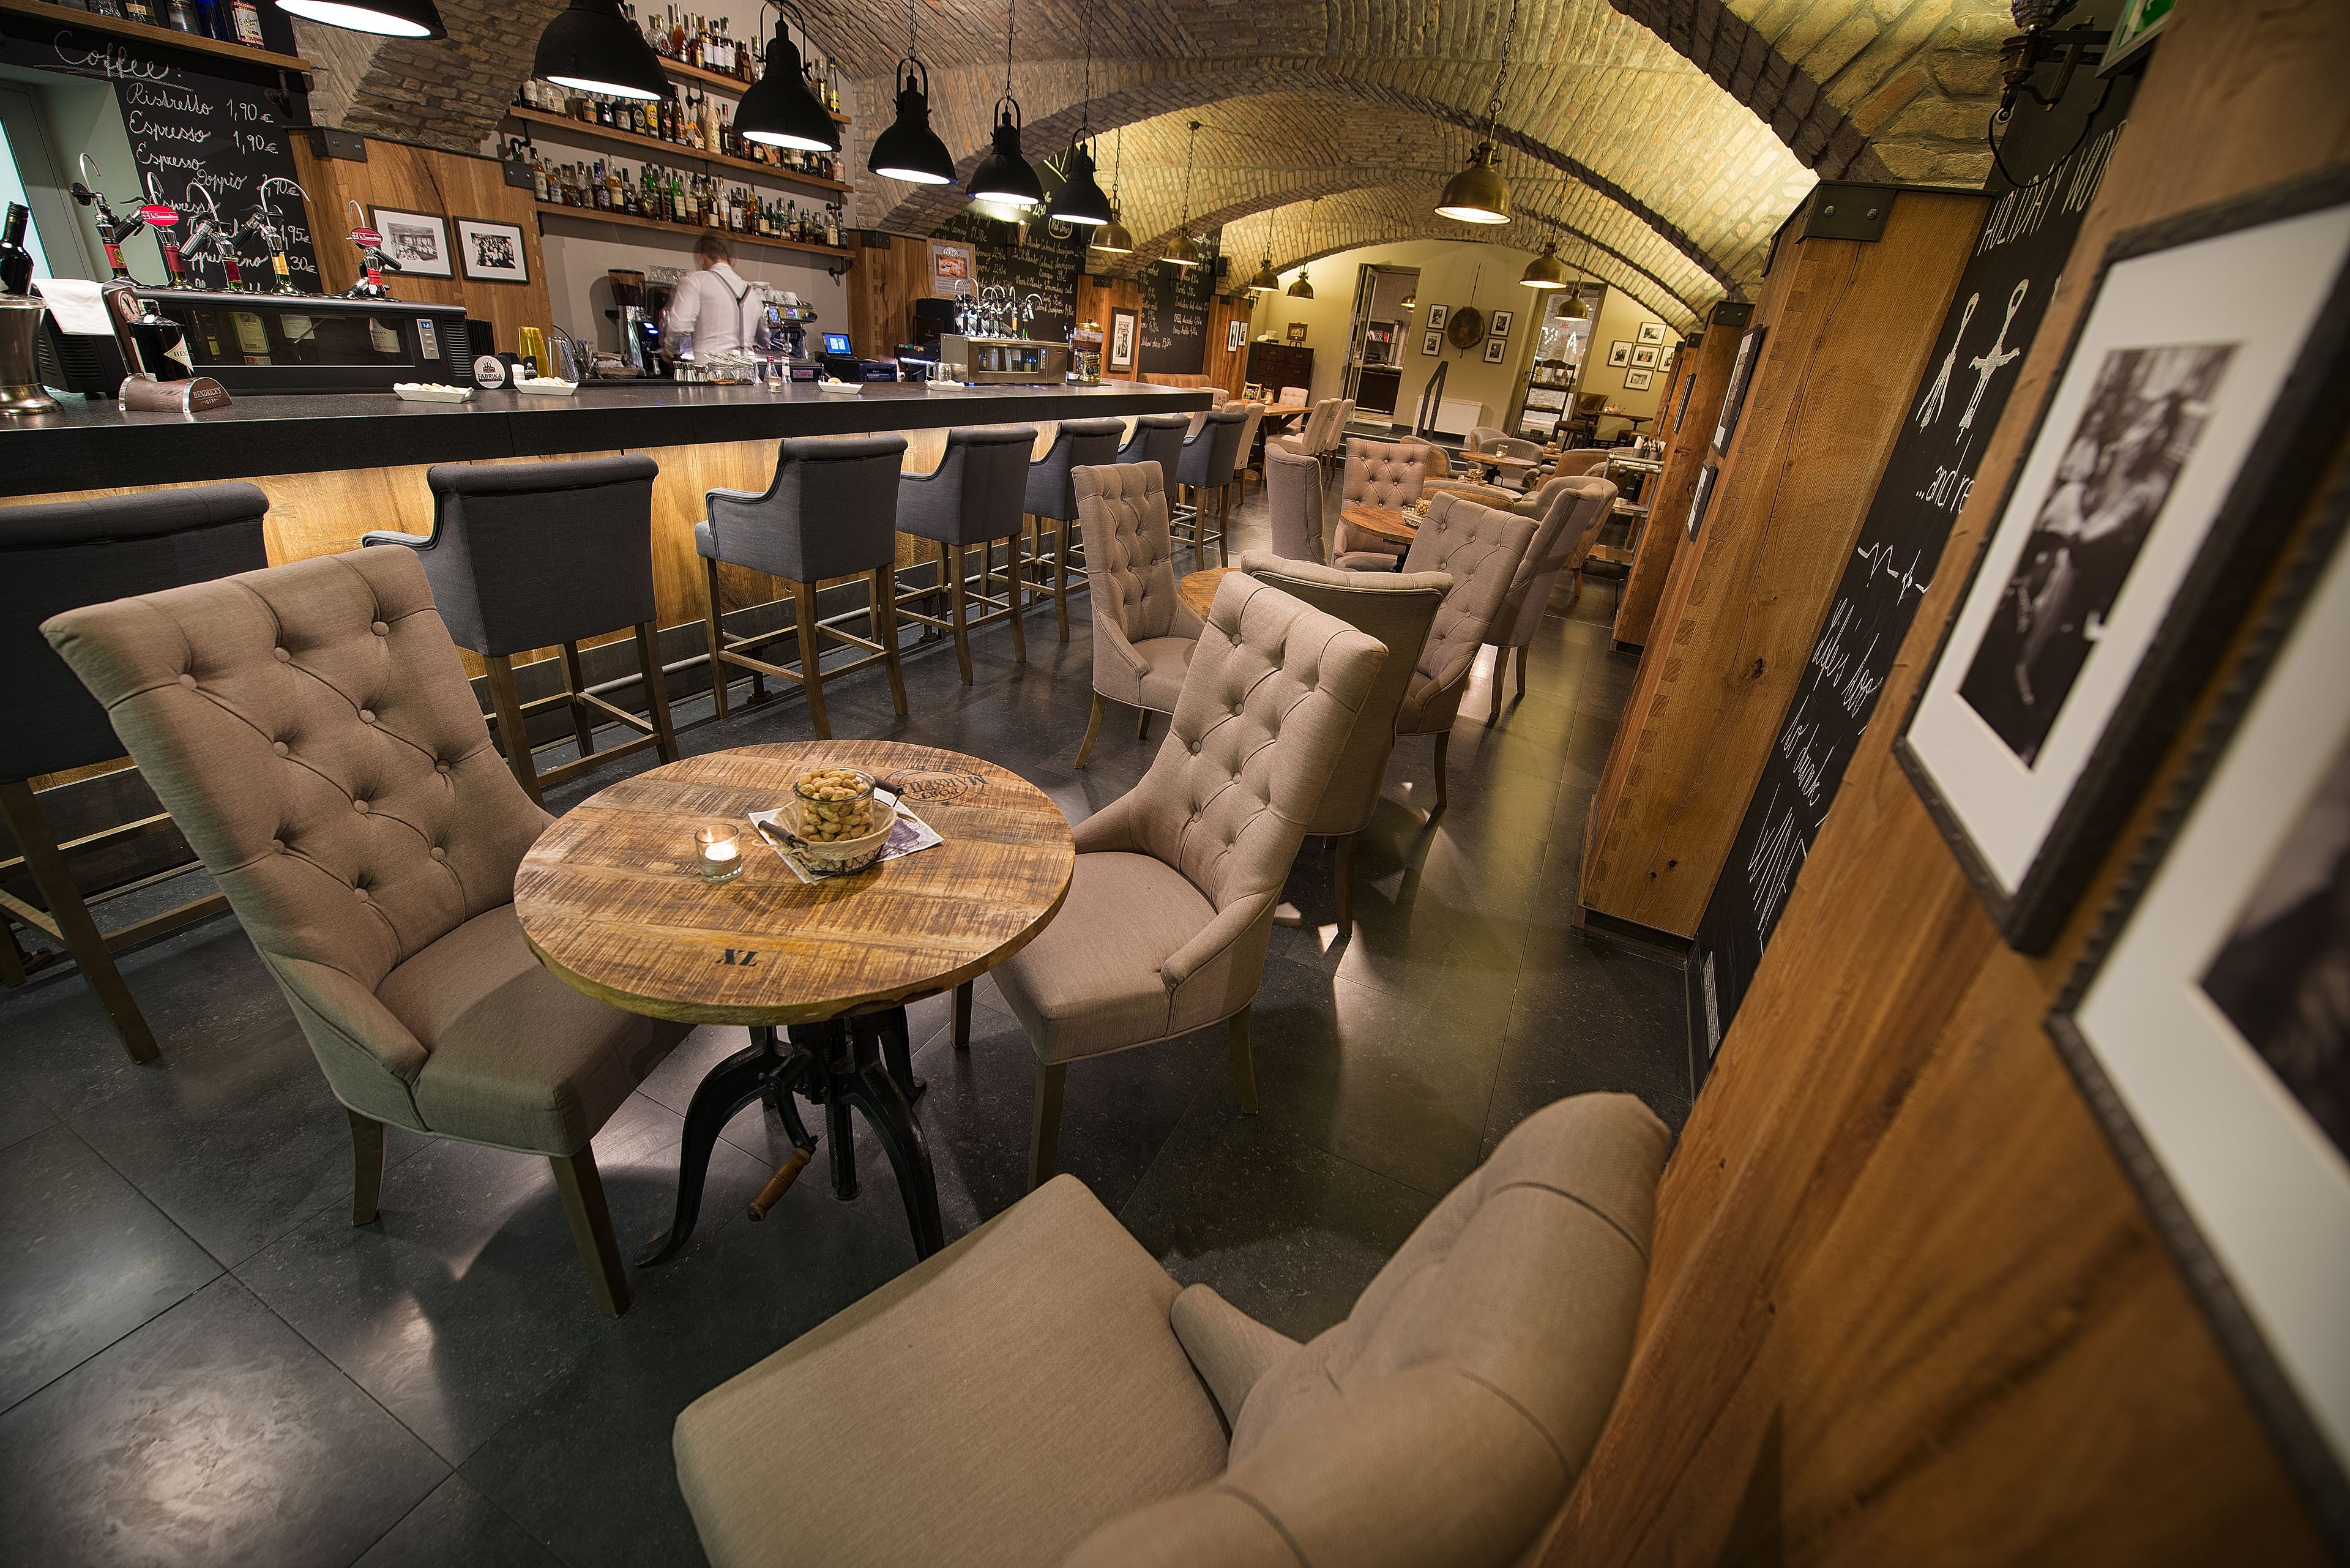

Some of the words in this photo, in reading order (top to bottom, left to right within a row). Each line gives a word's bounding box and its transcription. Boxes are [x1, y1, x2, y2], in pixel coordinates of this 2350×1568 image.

[127, 83, 214, 115] Ristretto
[129, 110, 211, 143] Espresso
[136, 141, 206, 172] Espresso
[192, 169, 247, 195] Doppio
[1977, 155, 2072, 256] HOLIDAY
[193, 387, 222, 398] HENDRICK'S
[1792, 723, 1835, 807] drink
[919, 788, 960, 800] PORT
